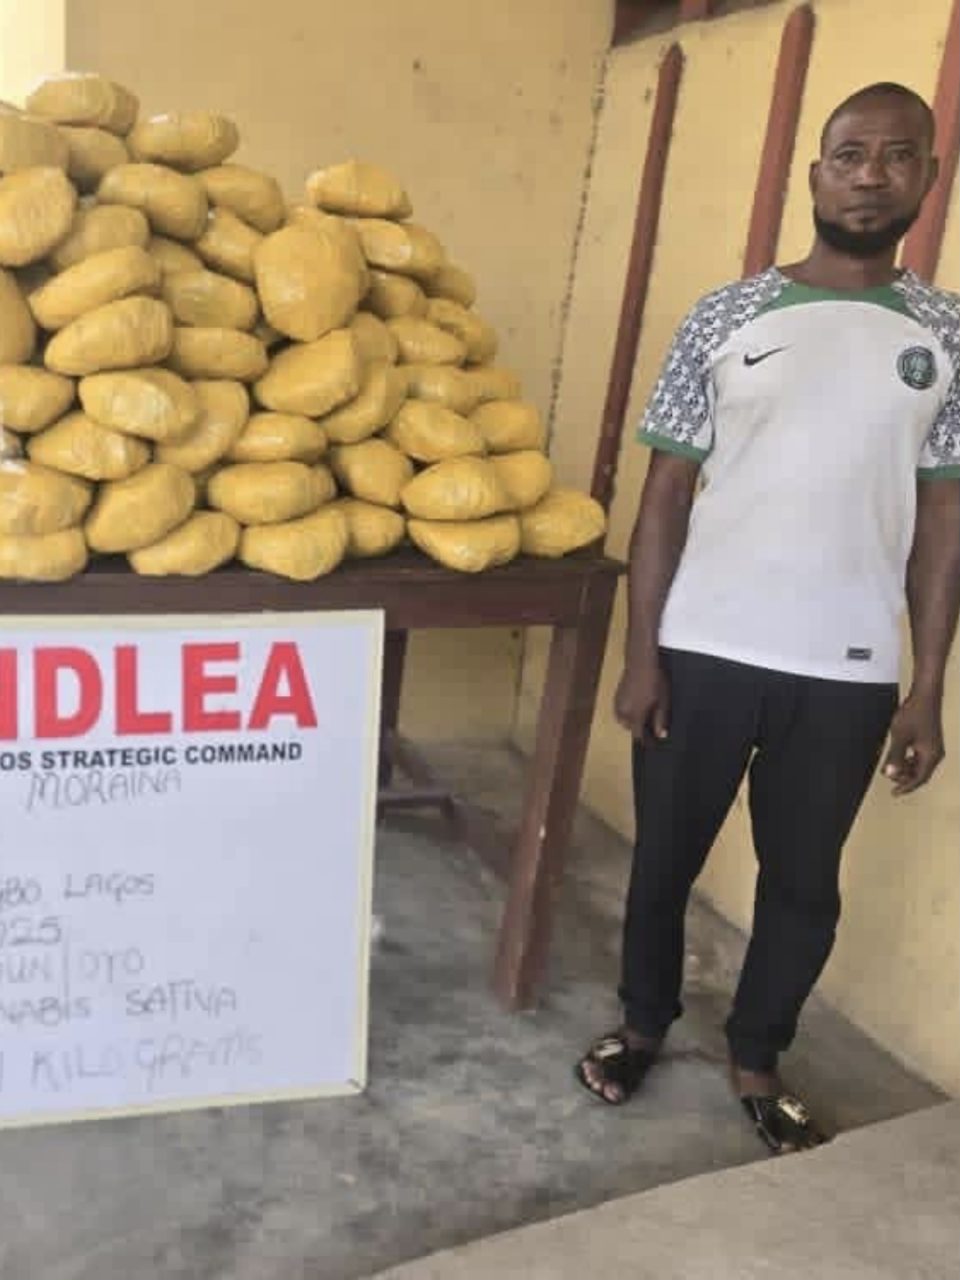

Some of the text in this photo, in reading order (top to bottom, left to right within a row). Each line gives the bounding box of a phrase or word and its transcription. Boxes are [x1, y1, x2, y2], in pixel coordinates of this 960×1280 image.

[40, 746, 178, 770] STRATEGIC
[184, 742, 303, 765] COMMAND
[63, 872, 155, 903] LAGOS
